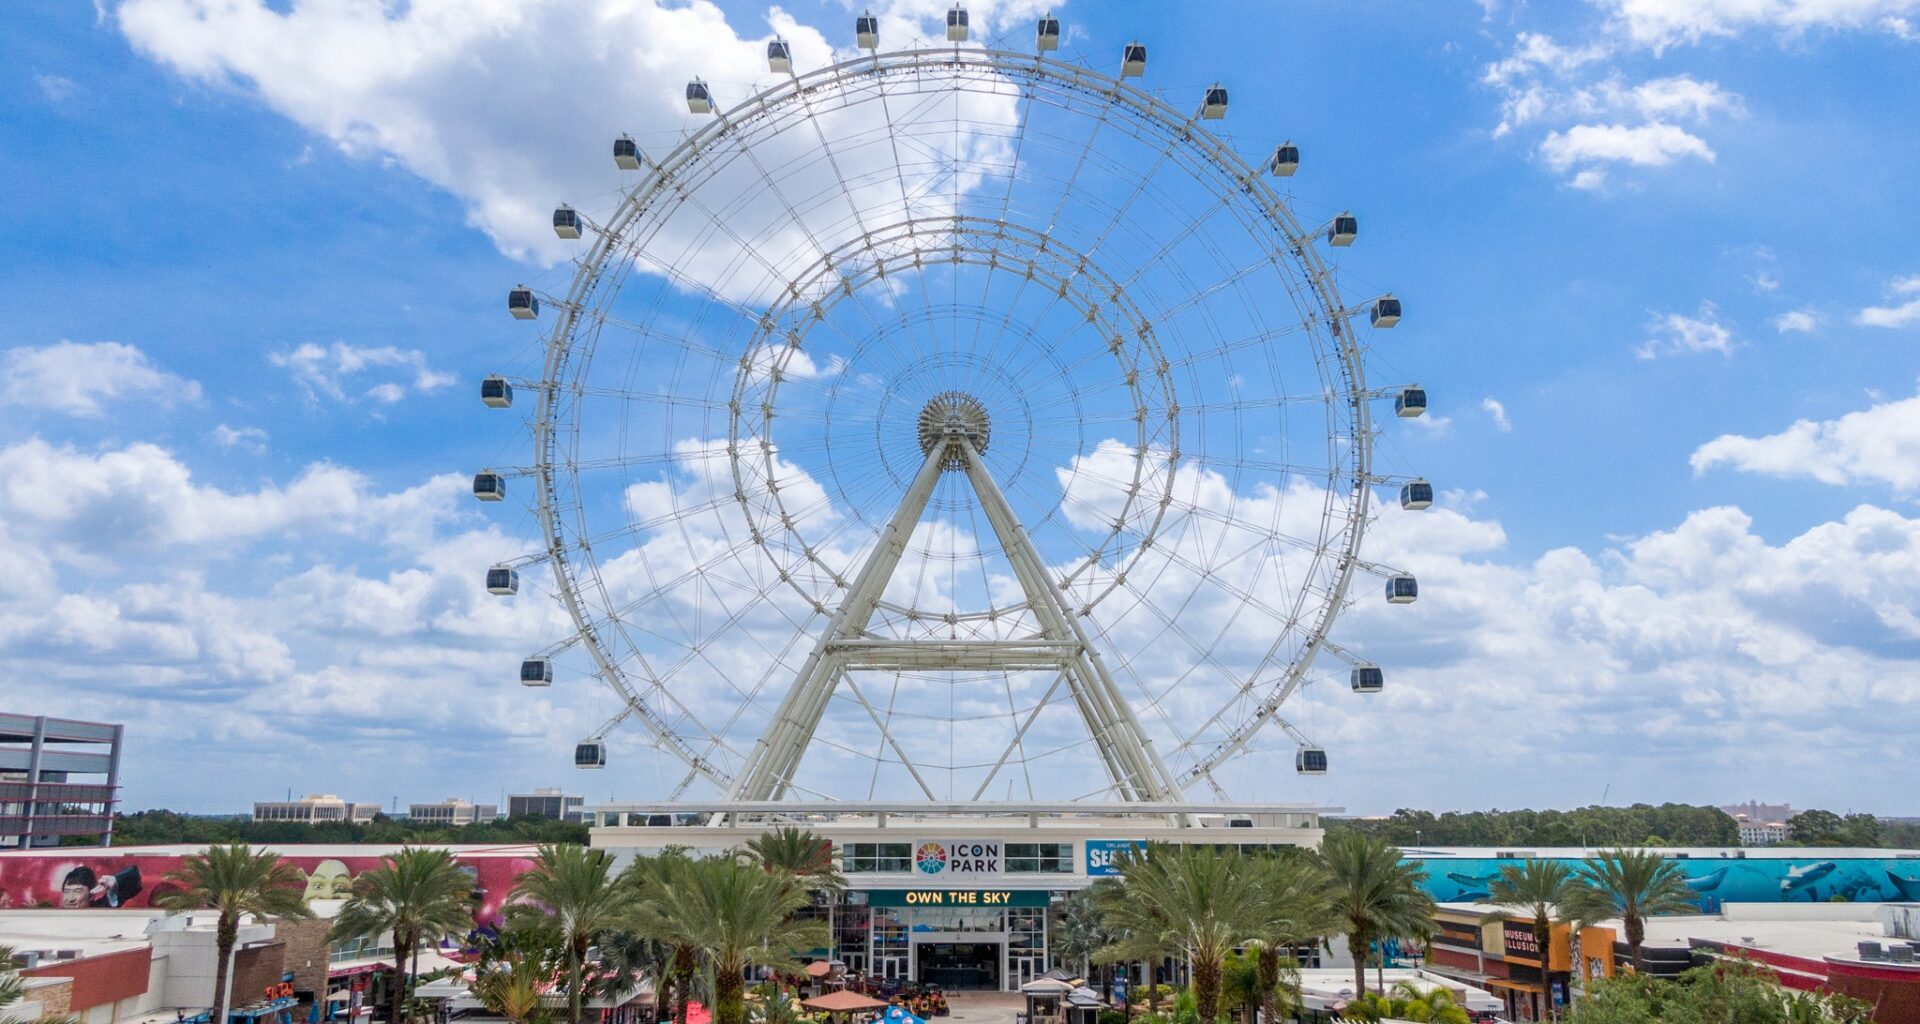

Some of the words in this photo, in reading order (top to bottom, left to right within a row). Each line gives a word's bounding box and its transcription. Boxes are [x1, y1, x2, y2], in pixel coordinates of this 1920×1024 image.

[951, 844, 998, 858] ICON
[951, 860, 998, 872] PARK
[906, 892, 942, 903] OWN
[949, 892, 977, 903] THE
[983, 892, 1011, 903] SKY
[1504, 929, 1533, 942] MUSEUM
